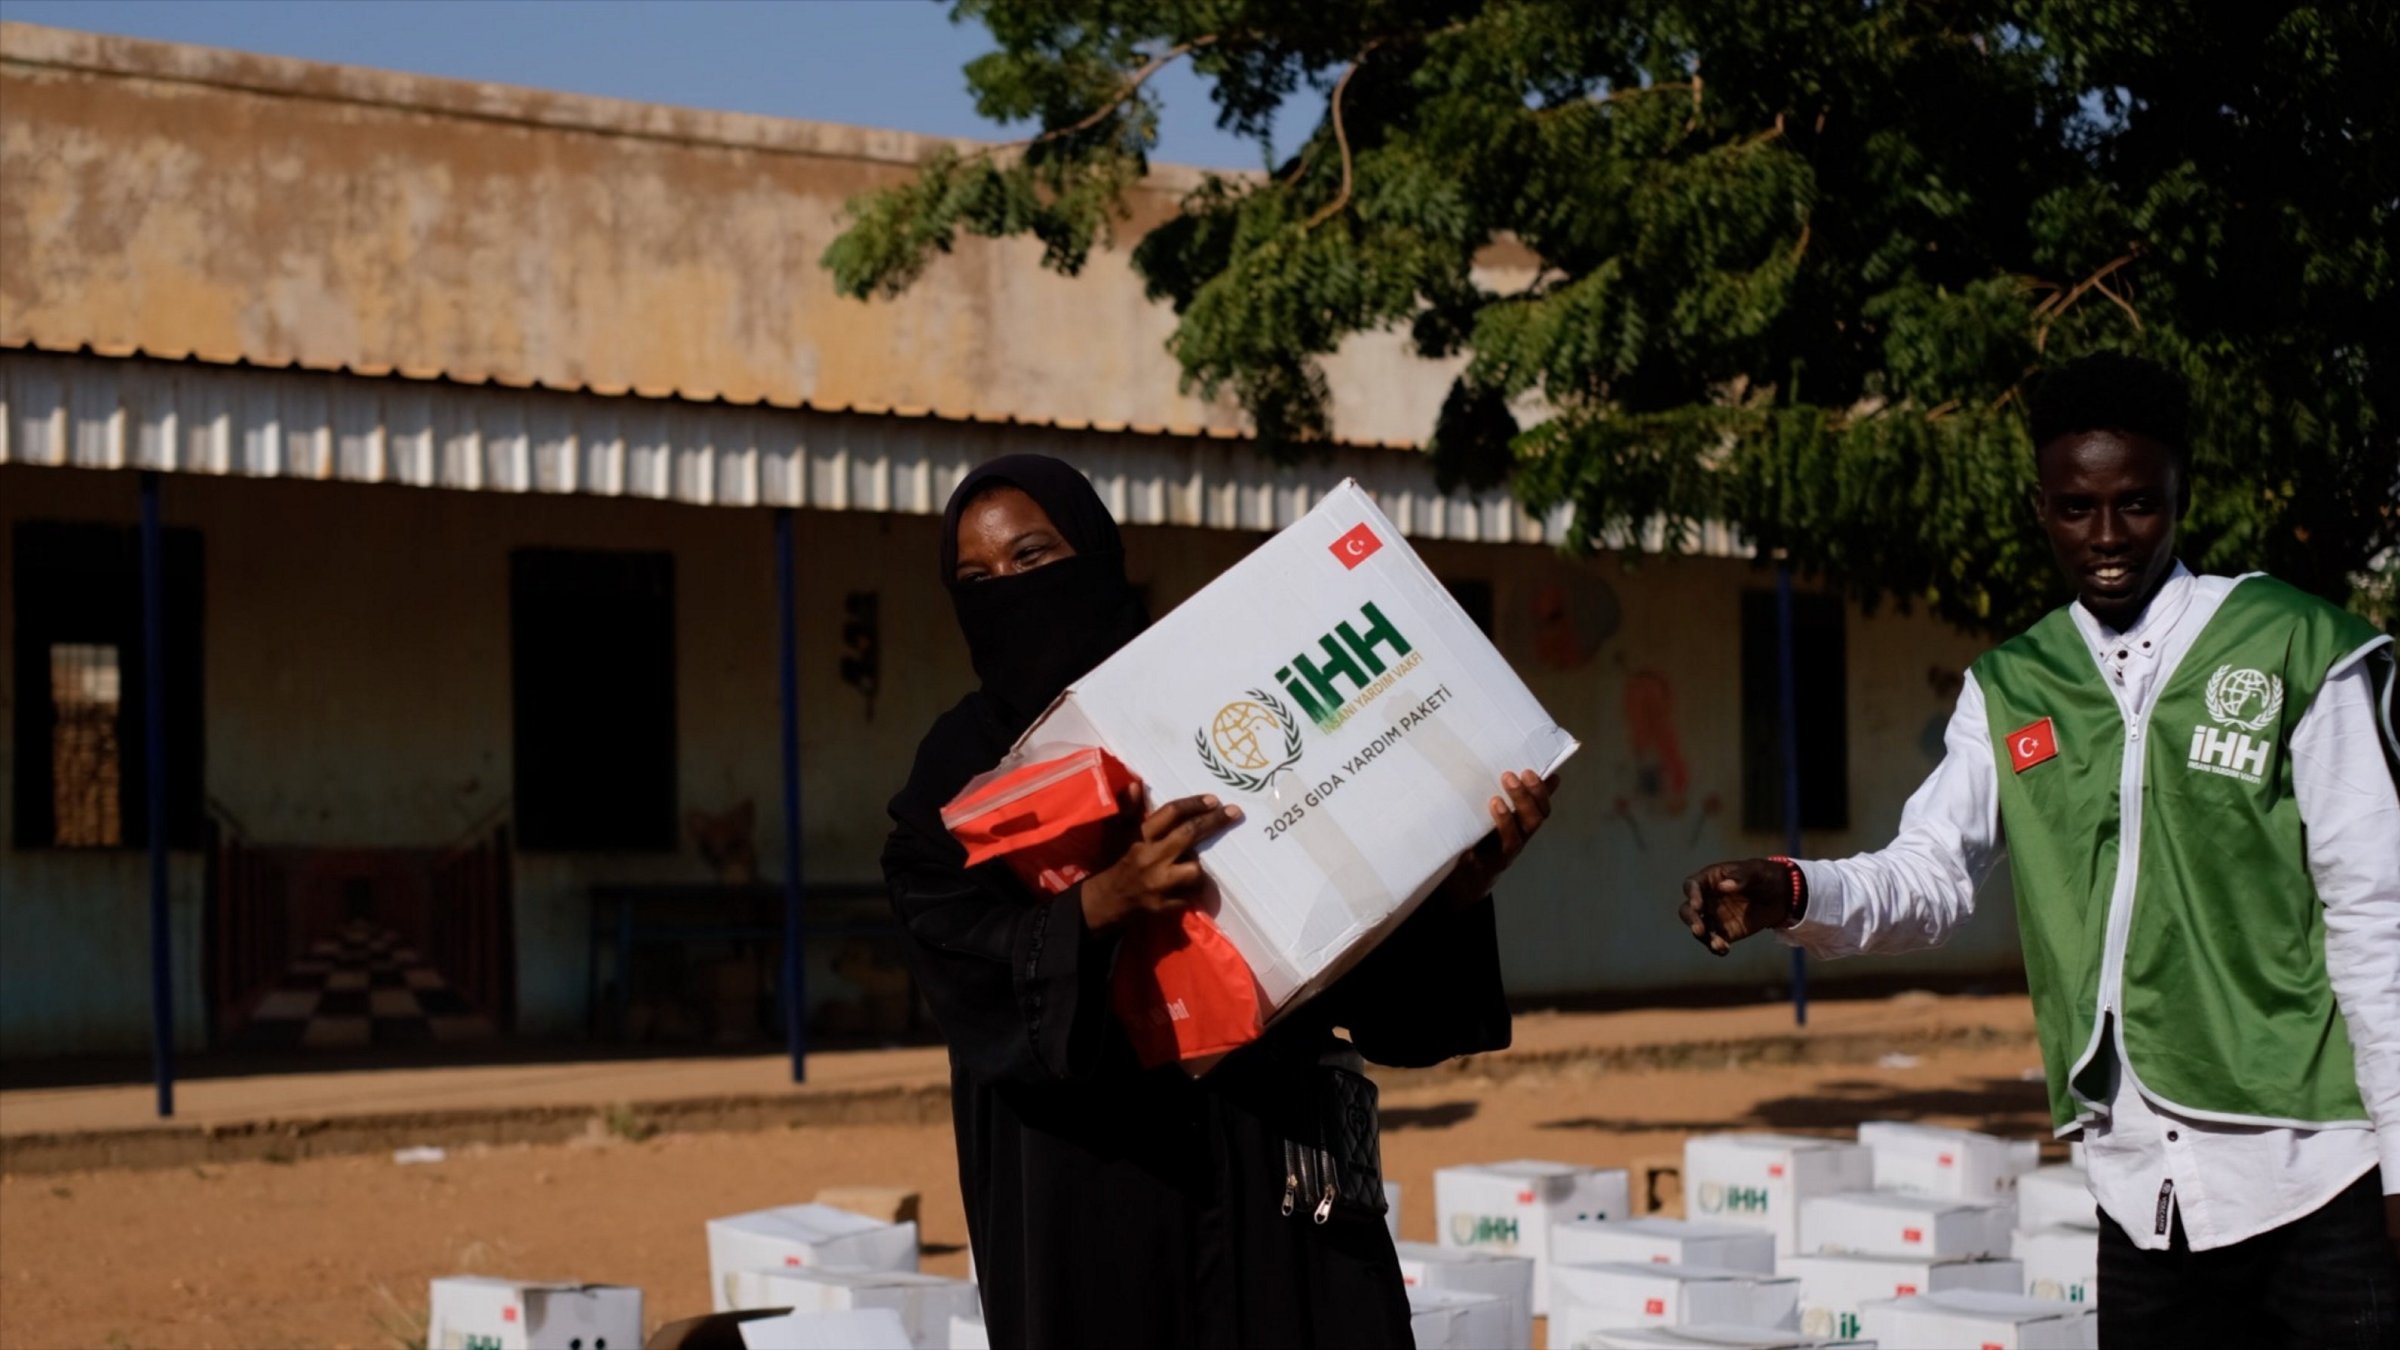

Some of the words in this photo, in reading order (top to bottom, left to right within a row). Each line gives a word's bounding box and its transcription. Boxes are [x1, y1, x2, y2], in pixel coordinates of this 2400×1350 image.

[1354, 673, 1397, 708] YARDIM
[1391, 651, 1424, 679] VAKFI
[1264, 804, 1305, 840] 2025
[1304, 774, 1345, 807] GIDA
[1342, 726, 1403, 775] YARDIM
[1399, 684, 1452, 731] PAKETİ
